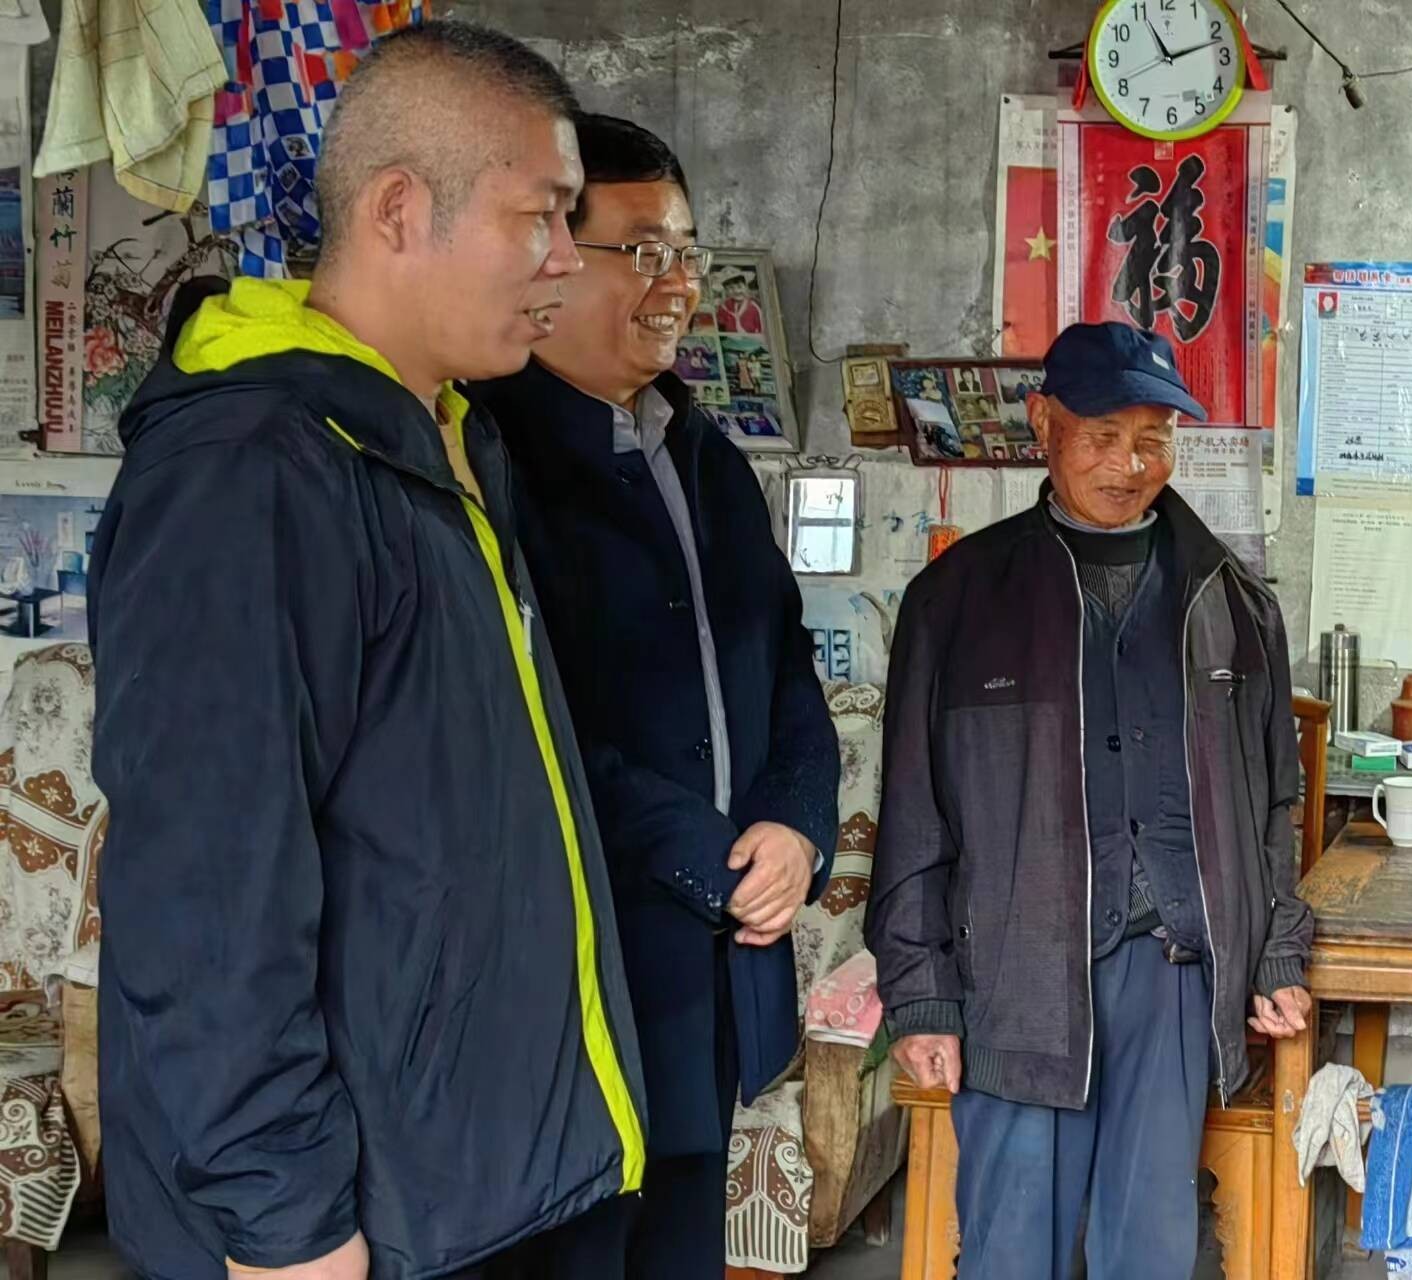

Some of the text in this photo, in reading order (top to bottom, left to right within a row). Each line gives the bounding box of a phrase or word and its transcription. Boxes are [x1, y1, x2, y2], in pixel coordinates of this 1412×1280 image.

[1131, 1, 1147, 21] 11
[1190, 1, 1198, 20] 1
[1111, 23, 1130, 42] 10
[1210, 20, 1223, 41] 2
[1108, 50, 1119, 68] 9
[1219, 47, 1231, 66] 3
[1118, 78, 1129, 97] 8
[1213, 76, 1224, 94] 4
[1139, 98, 1150, 116] 7
[1194, 96, 1206, 115] 5
[1166, 106, 1178, 125] 6
[1106, 153, 1221, 343] 福
[45, 300, 65, 433] MEILANZHUJU
